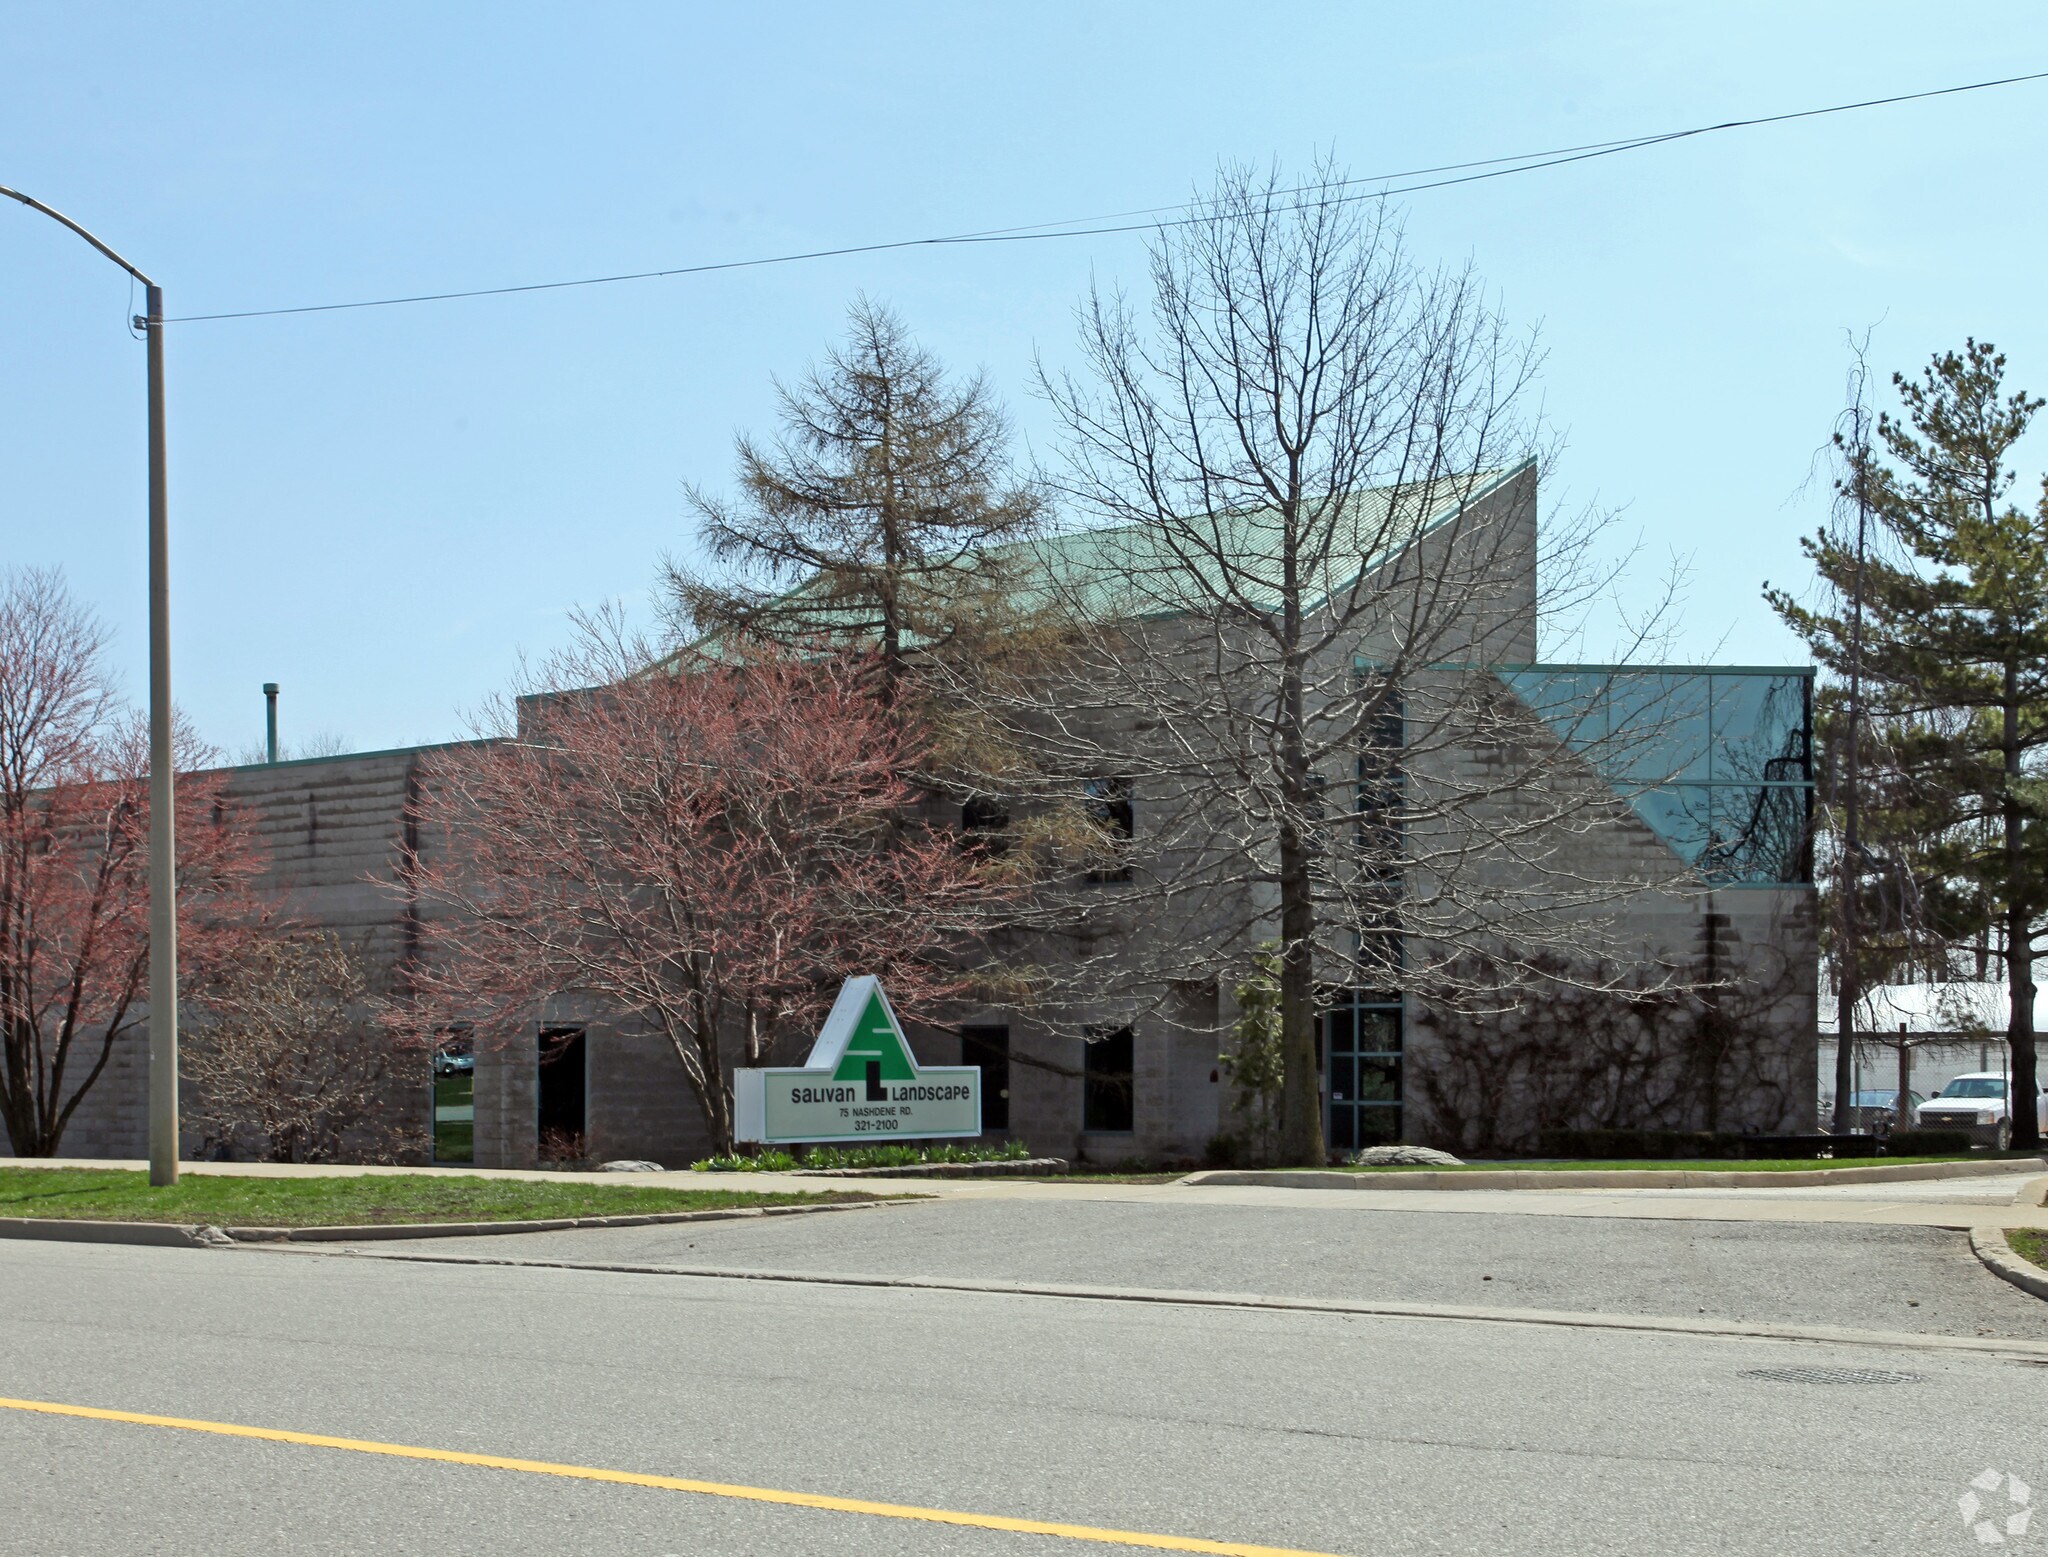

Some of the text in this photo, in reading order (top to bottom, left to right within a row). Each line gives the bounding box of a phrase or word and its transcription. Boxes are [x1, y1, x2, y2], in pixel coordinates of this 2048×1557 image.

[839, 1106, 913, 1118] 75 NASHDENE RD.
[854, 1119, 899, 1131] 321-2100
